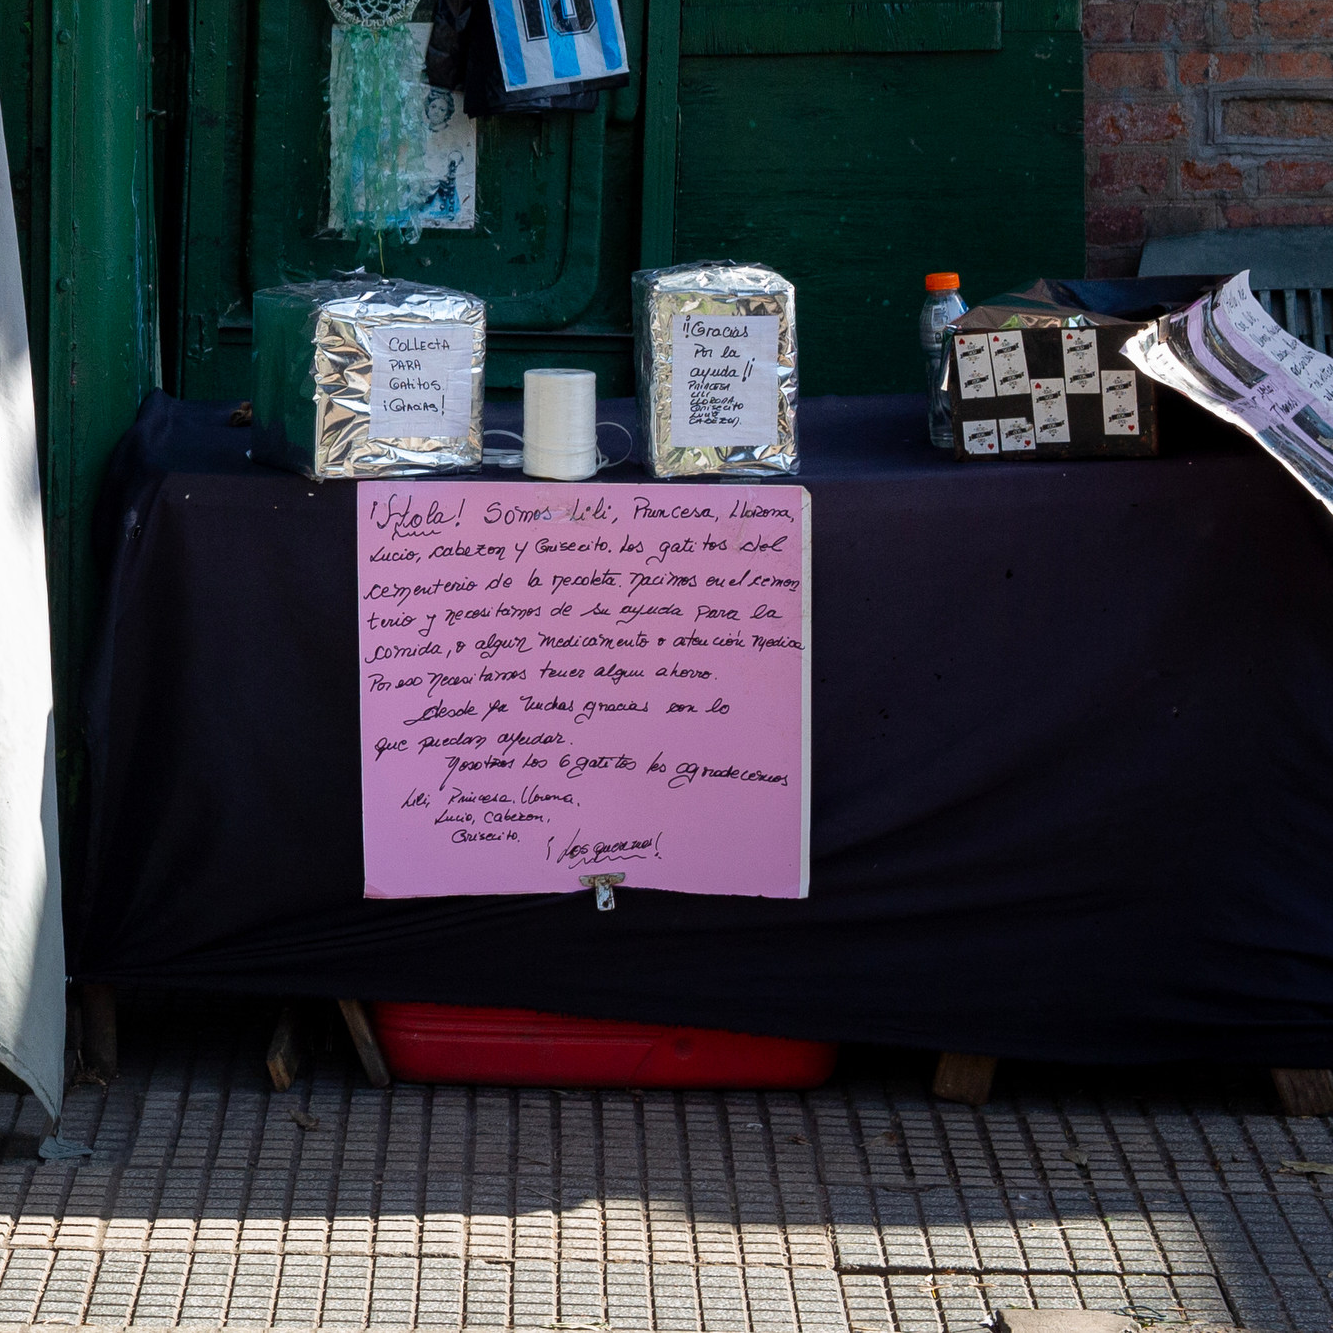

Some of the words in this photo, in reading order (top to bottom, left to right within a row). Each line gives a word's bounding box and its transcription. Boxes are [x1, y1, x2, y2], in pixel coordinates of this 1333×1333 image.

[721, 346, 740, 357] la
[389, 359, 421, 371] PARA
[484, 501, 552, 524] Somos
[739, 535, 788, 552] del
[485, 573, 512, 591] de
[528, 569, 543, 587] la
[550, 602, 573, 617] de
[616, 603, 684, 625] ayuda
[750, 604, 783, 619] la
[540, 660, 585, 679] tener
[705, 698, 730, 714] lo
[559, 754, 571, 767] 6
